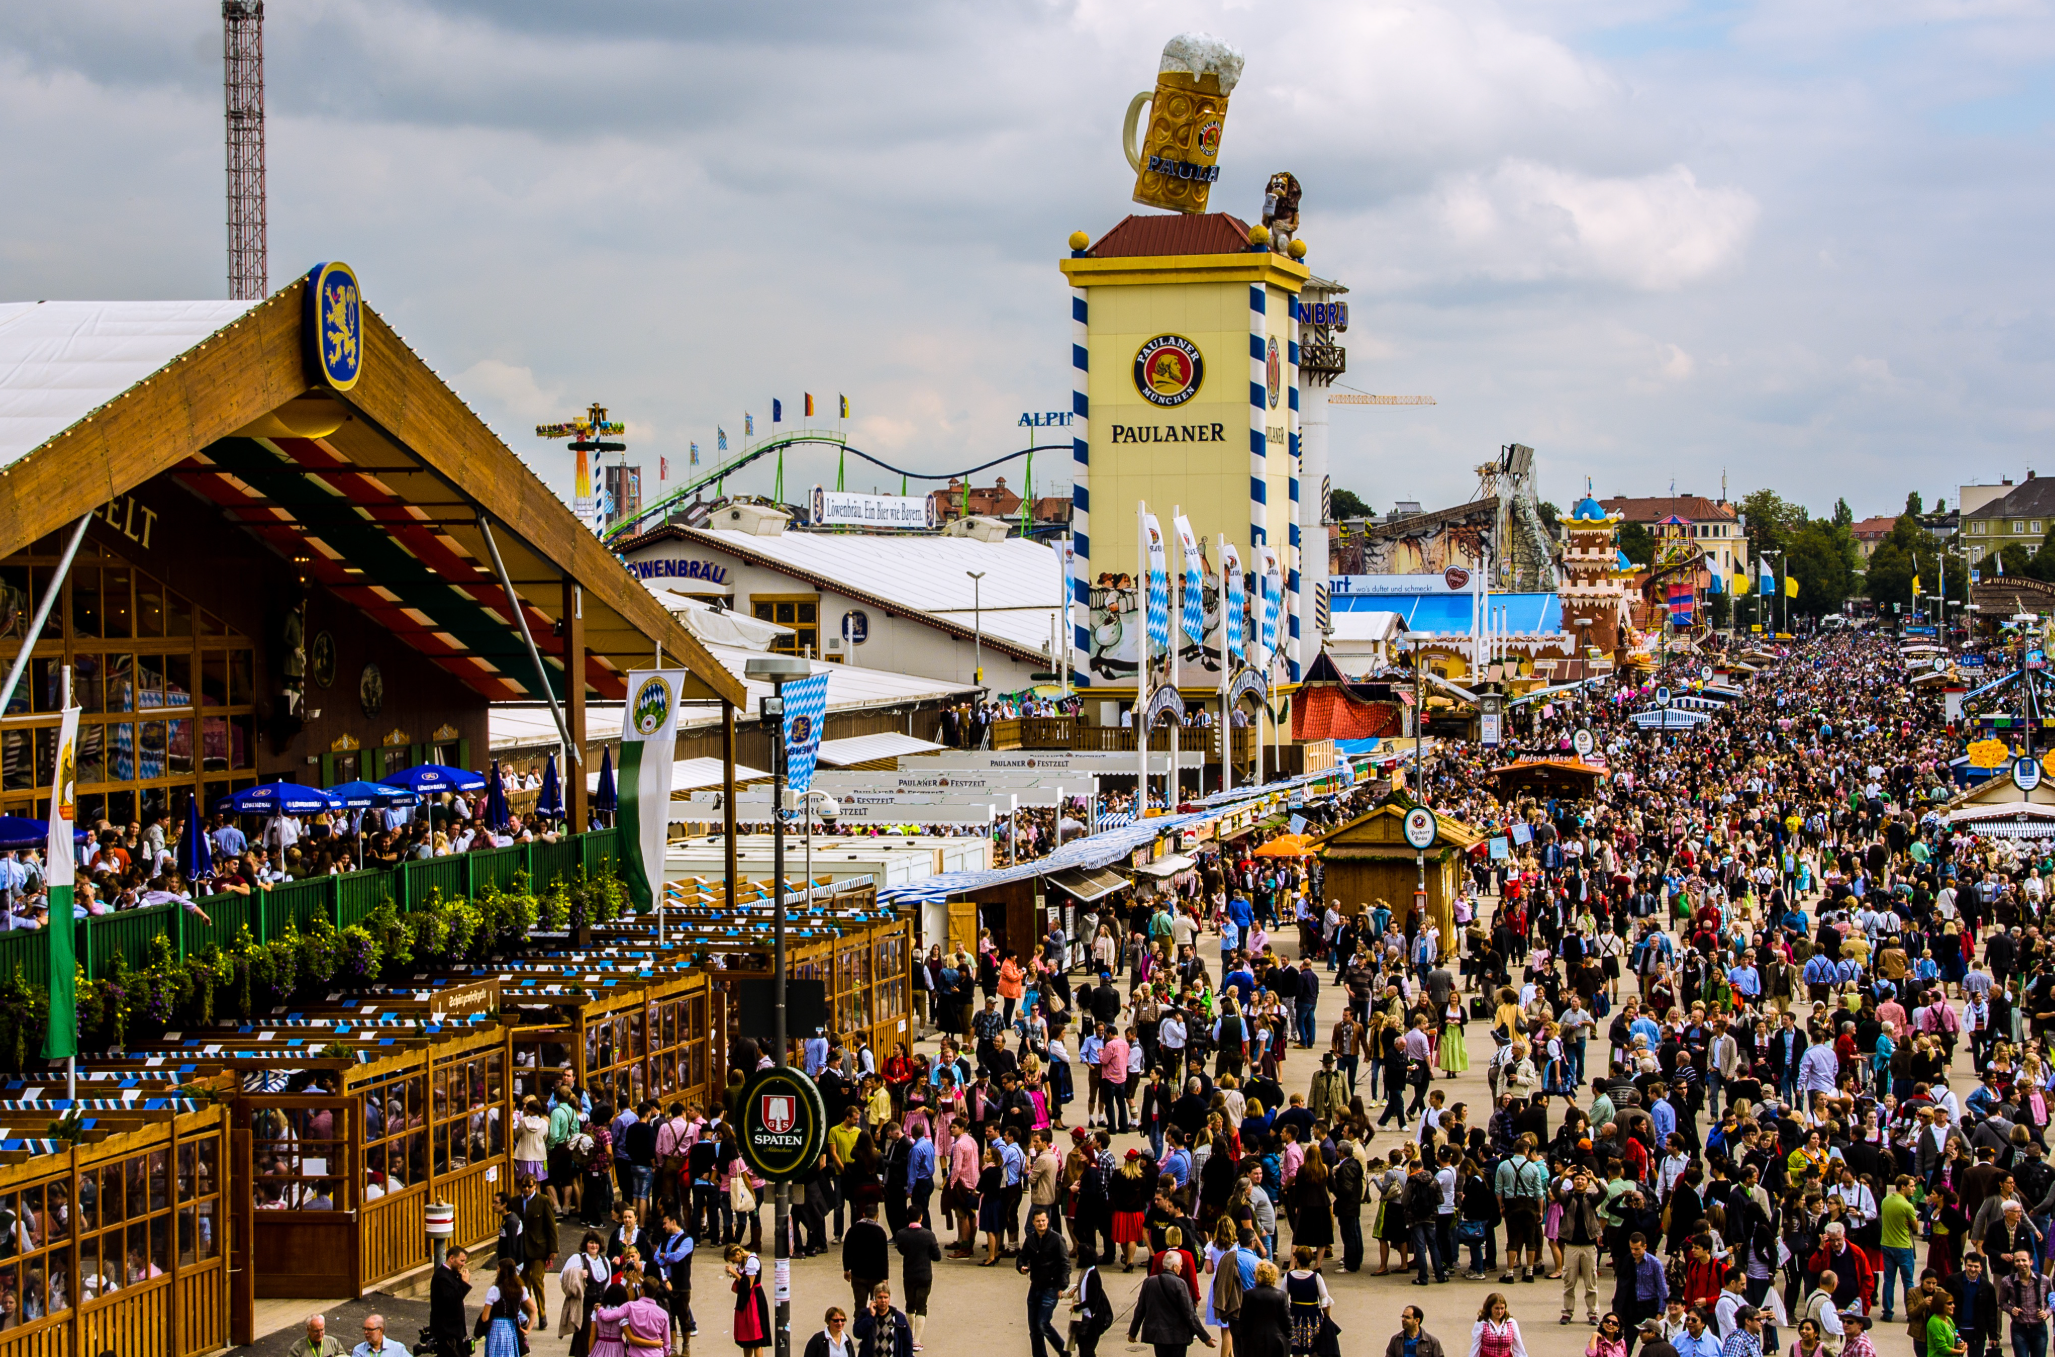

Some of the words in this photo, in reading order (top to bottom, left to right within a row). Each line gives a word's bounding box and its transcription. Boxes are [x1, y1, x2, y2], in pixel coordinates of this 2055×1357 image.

[1147, 155, 1220, 182] PAULA
[1298, 302, 1348, 325] NBRÄ
[1137, 336, 1200, 364] PAULANER
[1142, 386, 1195, 405] MÜNCHEN
[1111, 423, 1226, 443] PAULANER
[826, 498, 863, 518] Löwenbräu.
[865, 500, 876, 520] Ein
[877, 501, 889, 520] Bier
[890, 502, 900, 520] wie
[1405, 584, 1432, 592] schmeckt
[1993, 577, 2053, 594] WILDSTUBEN
[1520, 753, 1546, 762] Heisse
[1548, 753, 1574, 762] Nüsse
[950, 779, 987, 787] FESTZELT
[754, 1134, 803, 1145] SPATEN
